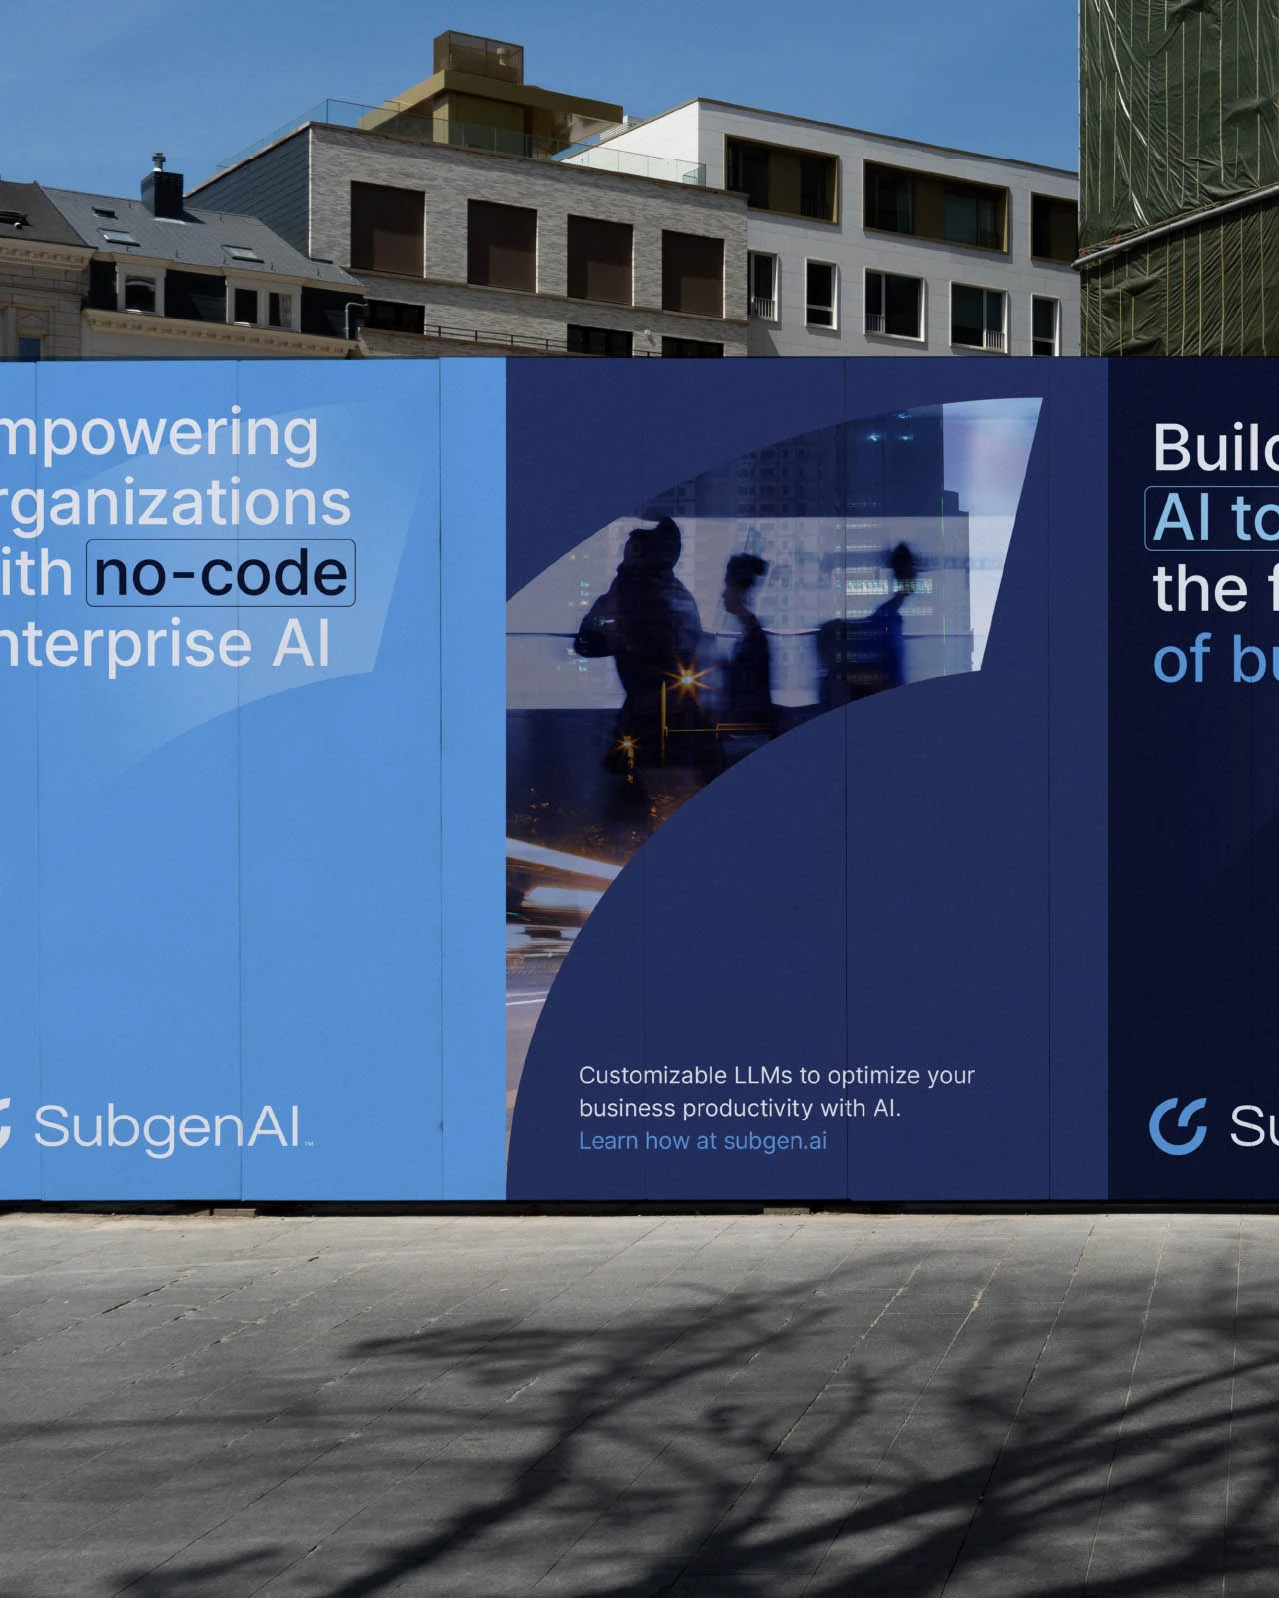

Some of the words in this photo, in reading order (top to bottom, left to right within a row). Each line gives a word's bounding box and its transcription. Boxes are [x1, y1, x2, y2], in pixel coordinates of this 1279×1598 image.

[1153, 492, 1209, 541] AI
[96, 547, 348, 597] no-code
[1152, 563, 1248, 612] the
[272, 618, 328, 667] AI
[1153, 631, 1212, 683] of
[579, 1065, 727, 1085] Customizable
[734, 1065, 793, 1085] LLMs
[799, 1066, 821, 1085] to
[828, 1065, 920, 1089] optimize
[927, 1069, 976, 1089] your
[34, 1102, 299, 1160] SubgenAI
[580, 1097, 676, 1118] business
[683, 1097, 814, 1121] productivity
[820, 1097, 865, 1118] with
[873, 1098, 901, 1118] AI.
[580, 1131, 638, 1150] Learn
[645, 1131, 690, 1150] how
[696, 1132, 718, 1150] at
[724, 1130, 828, 1155] subgen.ai
